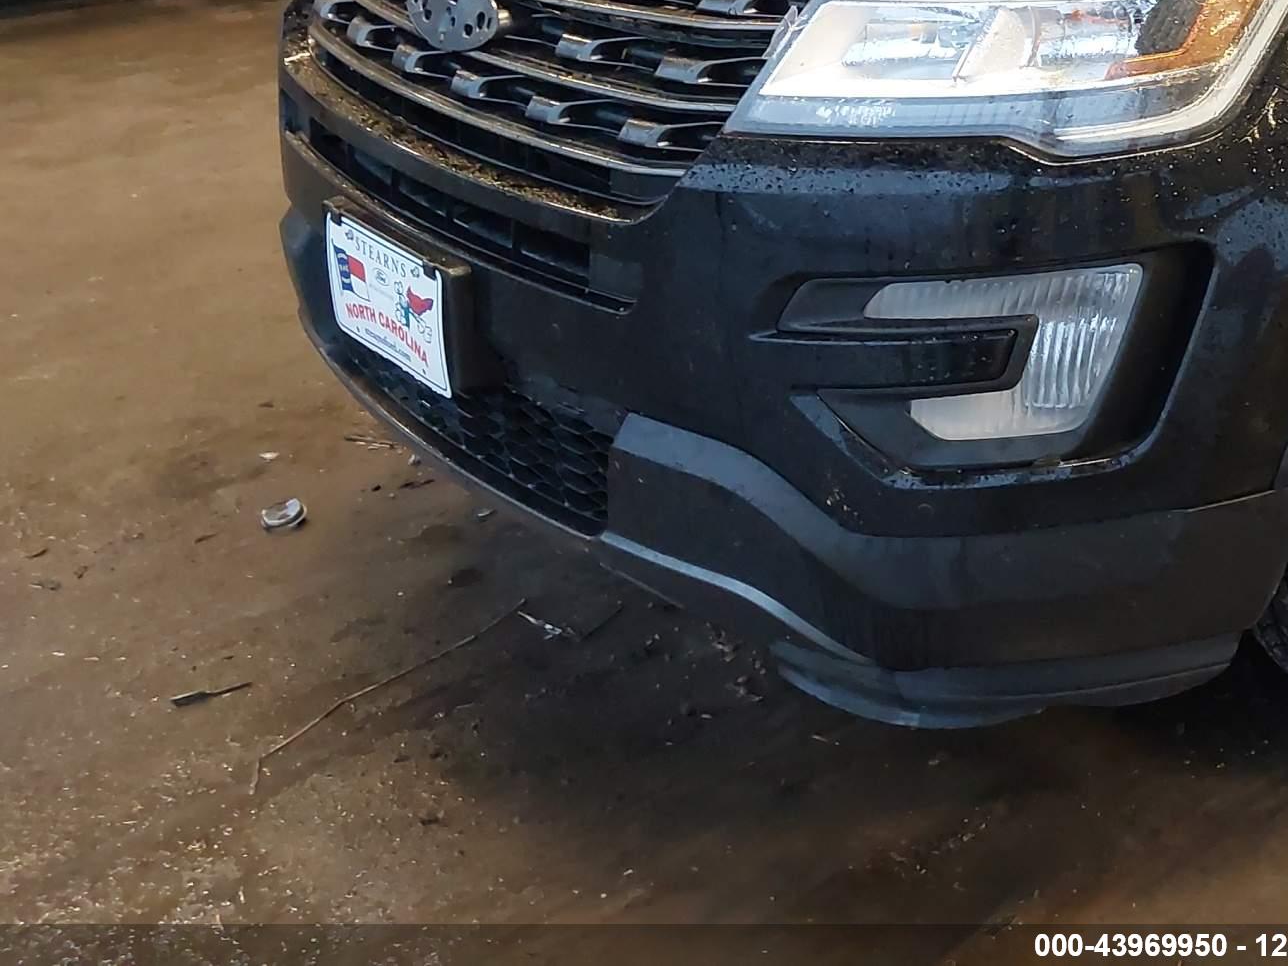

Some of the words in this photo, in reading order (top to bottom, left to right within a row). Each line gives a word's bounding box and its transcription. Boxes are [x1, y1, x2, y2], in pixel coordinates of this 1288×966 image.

[354, 236, 407, 278] STEARNS
[345, 302, 377, 325] NORTH
[378, 311, 429, 368] CAROLINA
